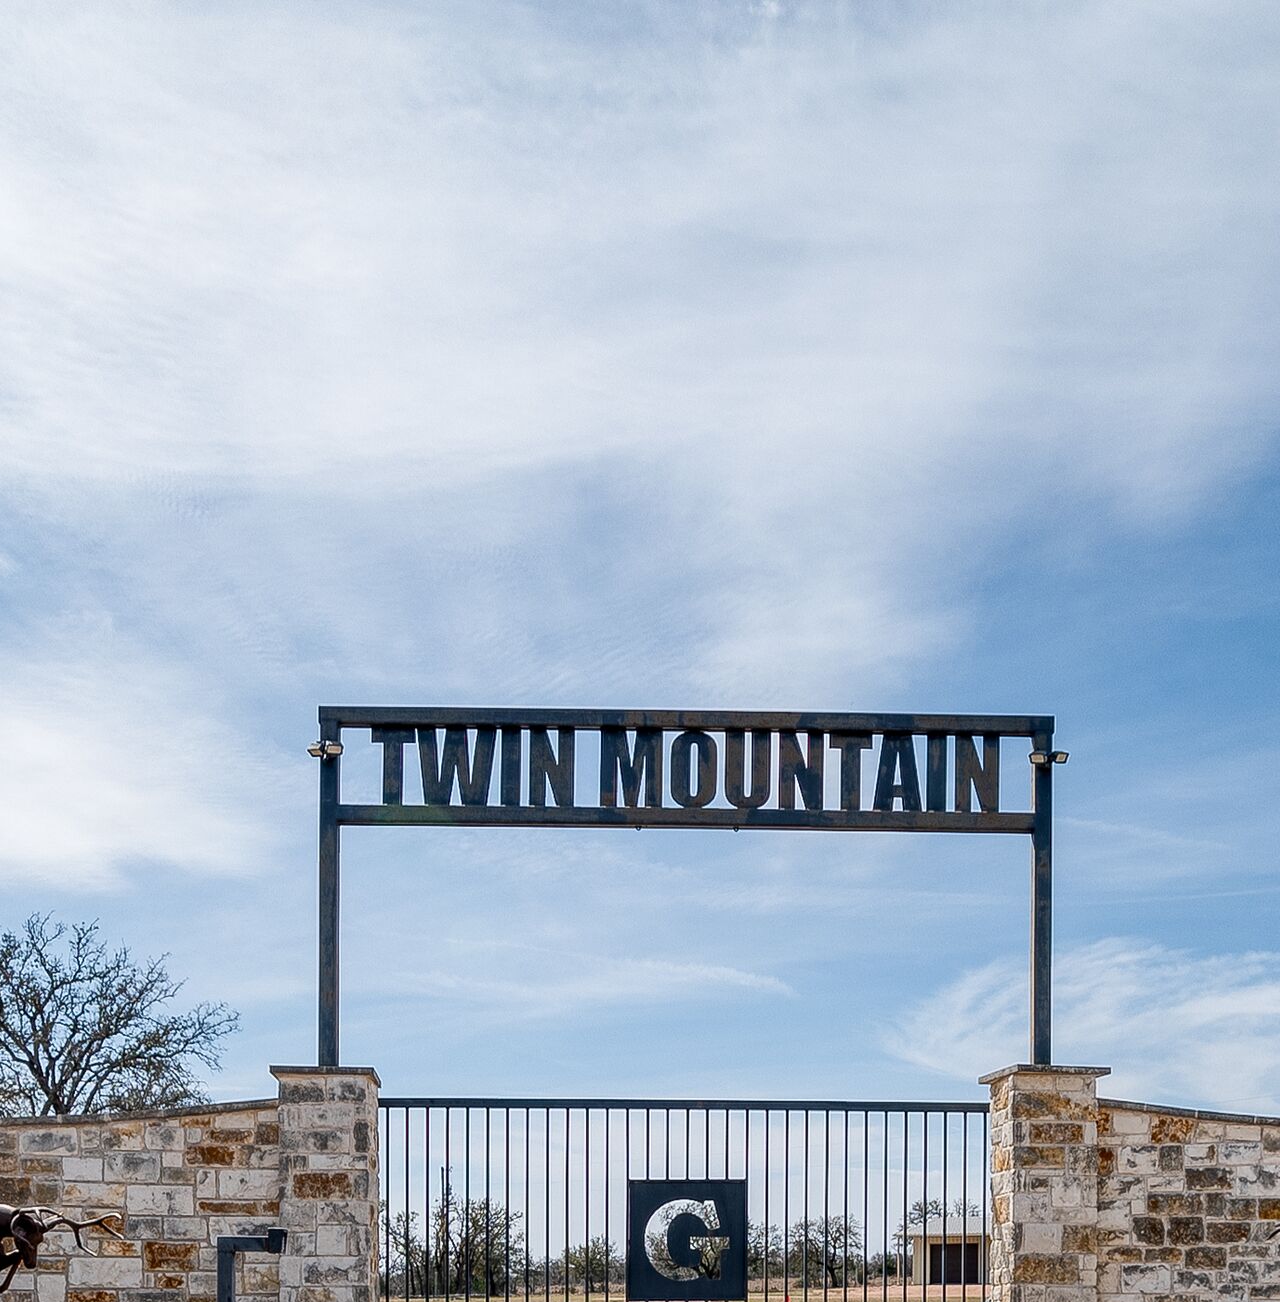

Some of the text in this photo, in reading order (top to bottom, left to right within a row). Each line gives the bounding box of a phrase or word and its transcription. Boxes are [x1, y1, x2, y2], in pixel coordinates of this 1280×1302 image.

[371, 726, 1000, 812] TWIN MOUNTAIN
[644, 1198, 730, 1281] G
